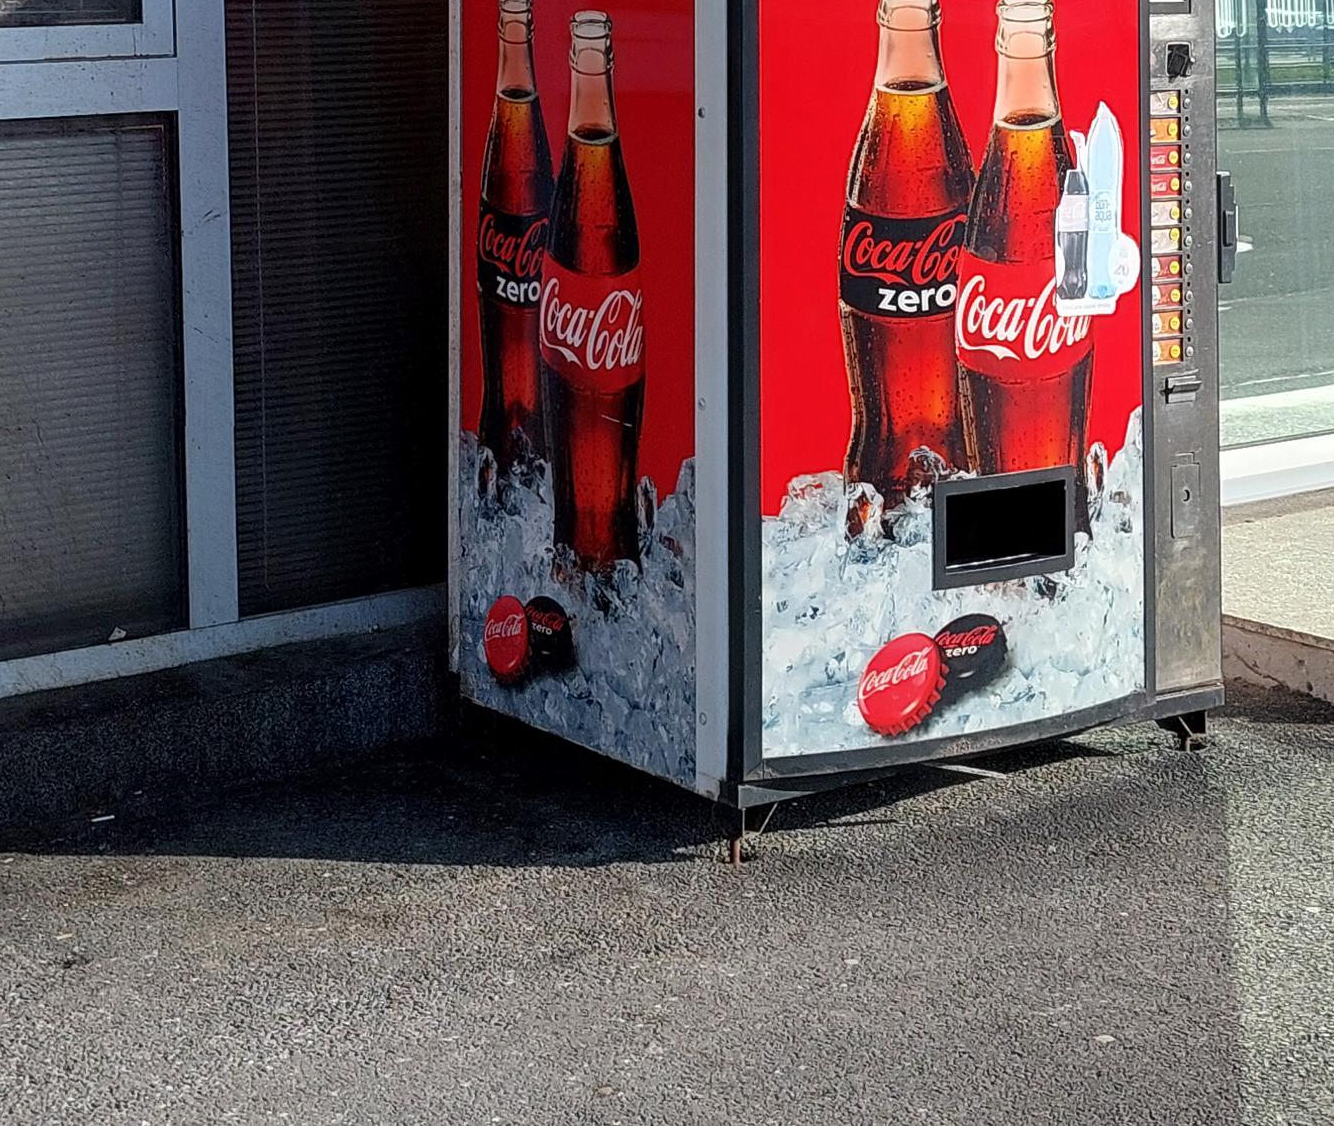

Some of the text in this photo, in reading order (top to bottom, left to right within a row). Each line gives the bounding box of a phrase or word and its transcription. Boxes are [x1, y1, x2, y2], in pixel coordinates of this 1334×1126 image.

[496, 276, 541, 303] zero
[878, 283, 958, 313] zero
[540, 278, 644, 370] Coca-Cola
[485, 613, 525, 642] Coca-Cola
[531, 622, 553, 636] zero
[945, 645, 978, 658] zero
[859, 645, 934, 700] Coca-Cola
